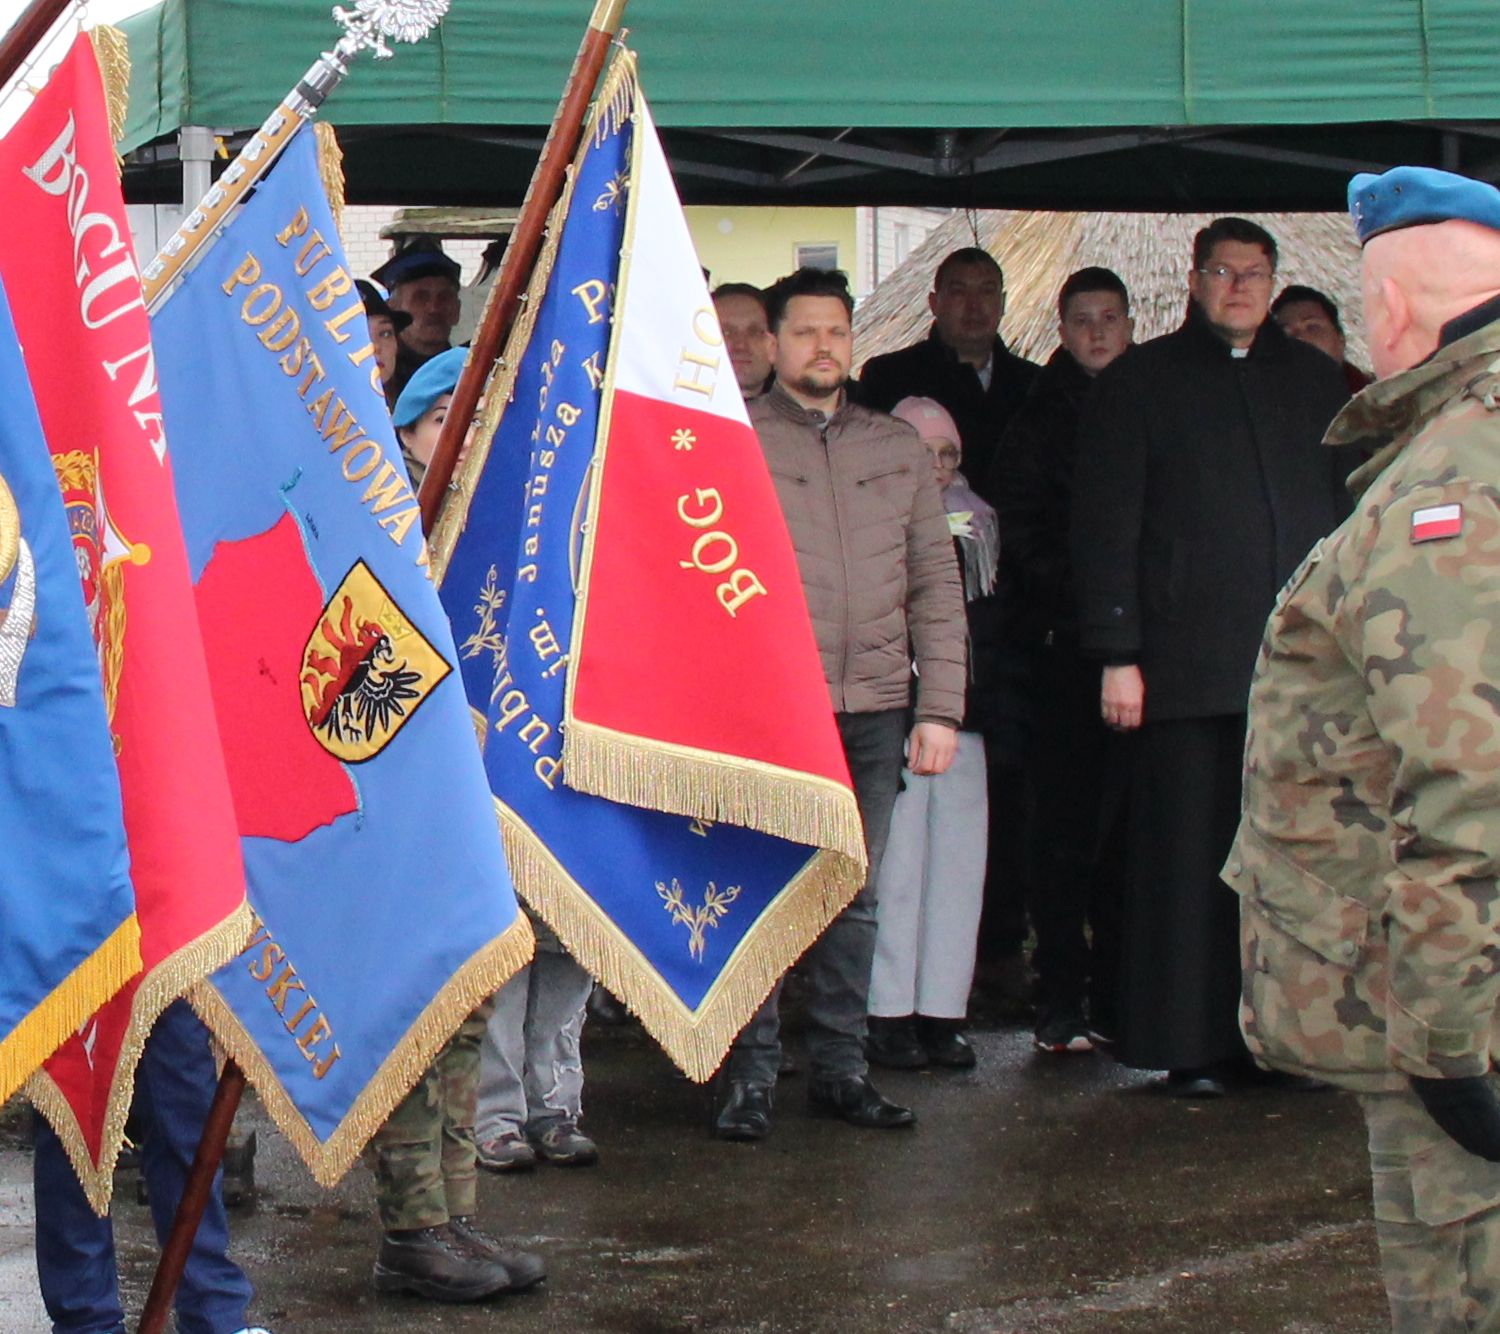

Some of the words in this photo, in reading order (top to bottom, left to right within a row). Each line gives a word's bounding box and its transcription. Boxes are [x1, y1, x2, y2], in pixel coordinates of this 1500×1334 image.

[221, 250, 422, 547] PODSTAWOWA
[518, 400, 583, 584] Janusza
[678, 487, 768, 618] BÓG
